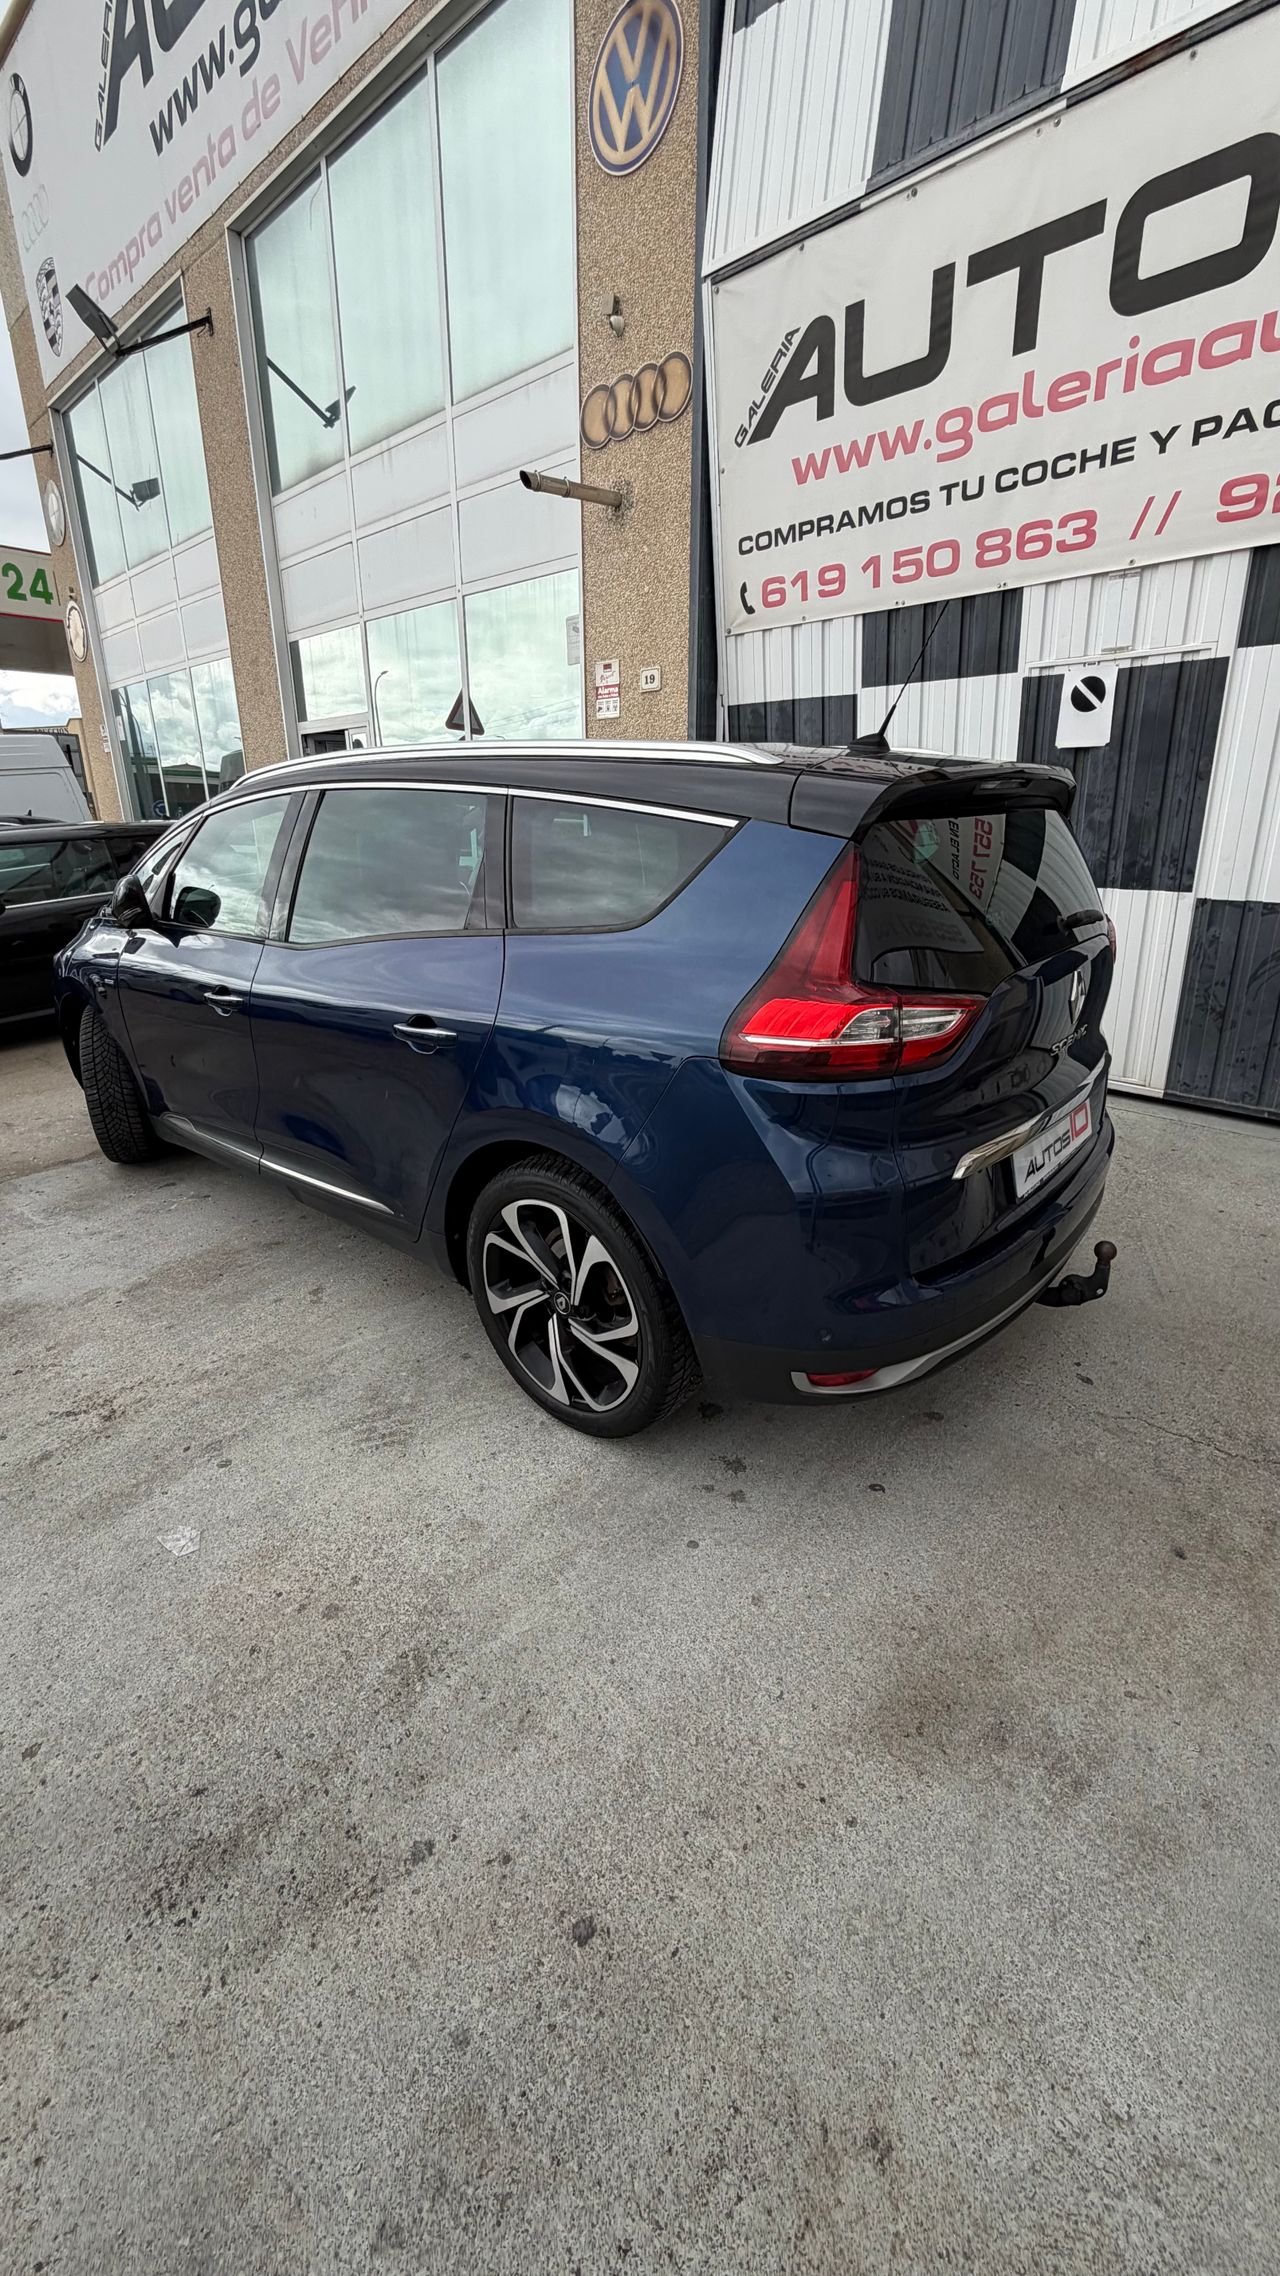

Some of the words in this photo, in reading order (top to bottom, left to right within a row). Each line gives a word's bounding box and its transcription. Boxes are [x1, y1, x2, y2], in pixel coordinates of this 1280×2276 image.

[94, 0, 113, 152] GALER
[85, 211, 162, 302] Compra
[164, 124, 237, 225] venta
[242, 73, 281, 141] de
[746, 131, 1280, 446] AUTO
[734, 327, 802, 449] GALERIA
[738, 490, 930, 556] COMPRAMOS
[939, 475, 985, 508] TU
[994, 436, 1137, 495] COCHE
[1150, 424, 1182, 455] Y
[760, 563, 847, 609] 619
[861, 538, 961, 590] 150
[975, 508, 1098, 569] 863
[1215, 473, 1280, 523] 9
[1, 562, 54, 605] 24
[644, 673, 656, 686] 19
